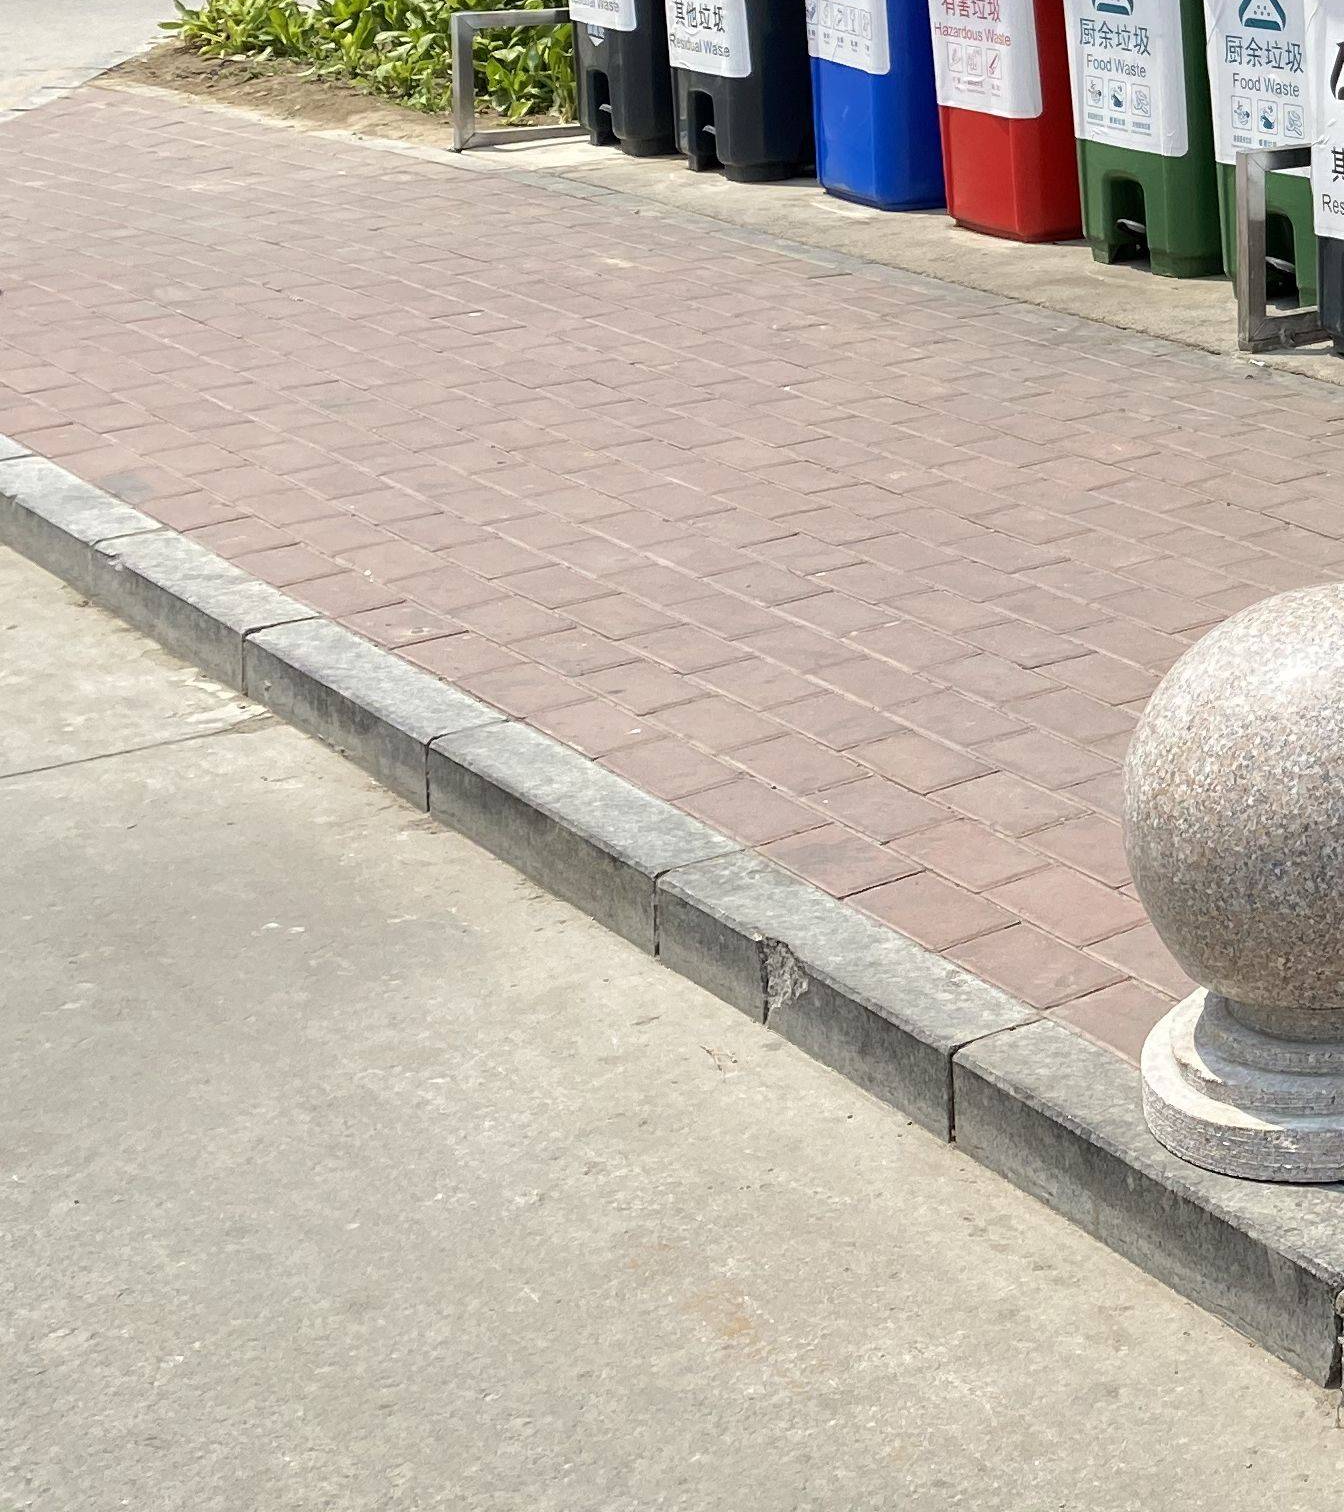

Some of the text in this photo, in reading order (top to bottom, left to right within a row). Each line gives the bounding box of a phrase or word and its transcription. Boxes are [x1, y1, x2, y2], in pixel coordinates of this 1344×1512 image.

[933, 21, 1012, 47] Hazardous Waste
[1079, 17, 1151, 57] 厨余垃圾
[1086, 53, 1146, 79] Food Waste
[1224, 34, 1305, 74] 厨余垃圾
[1232, 72, 1300, 98] Food Waste
